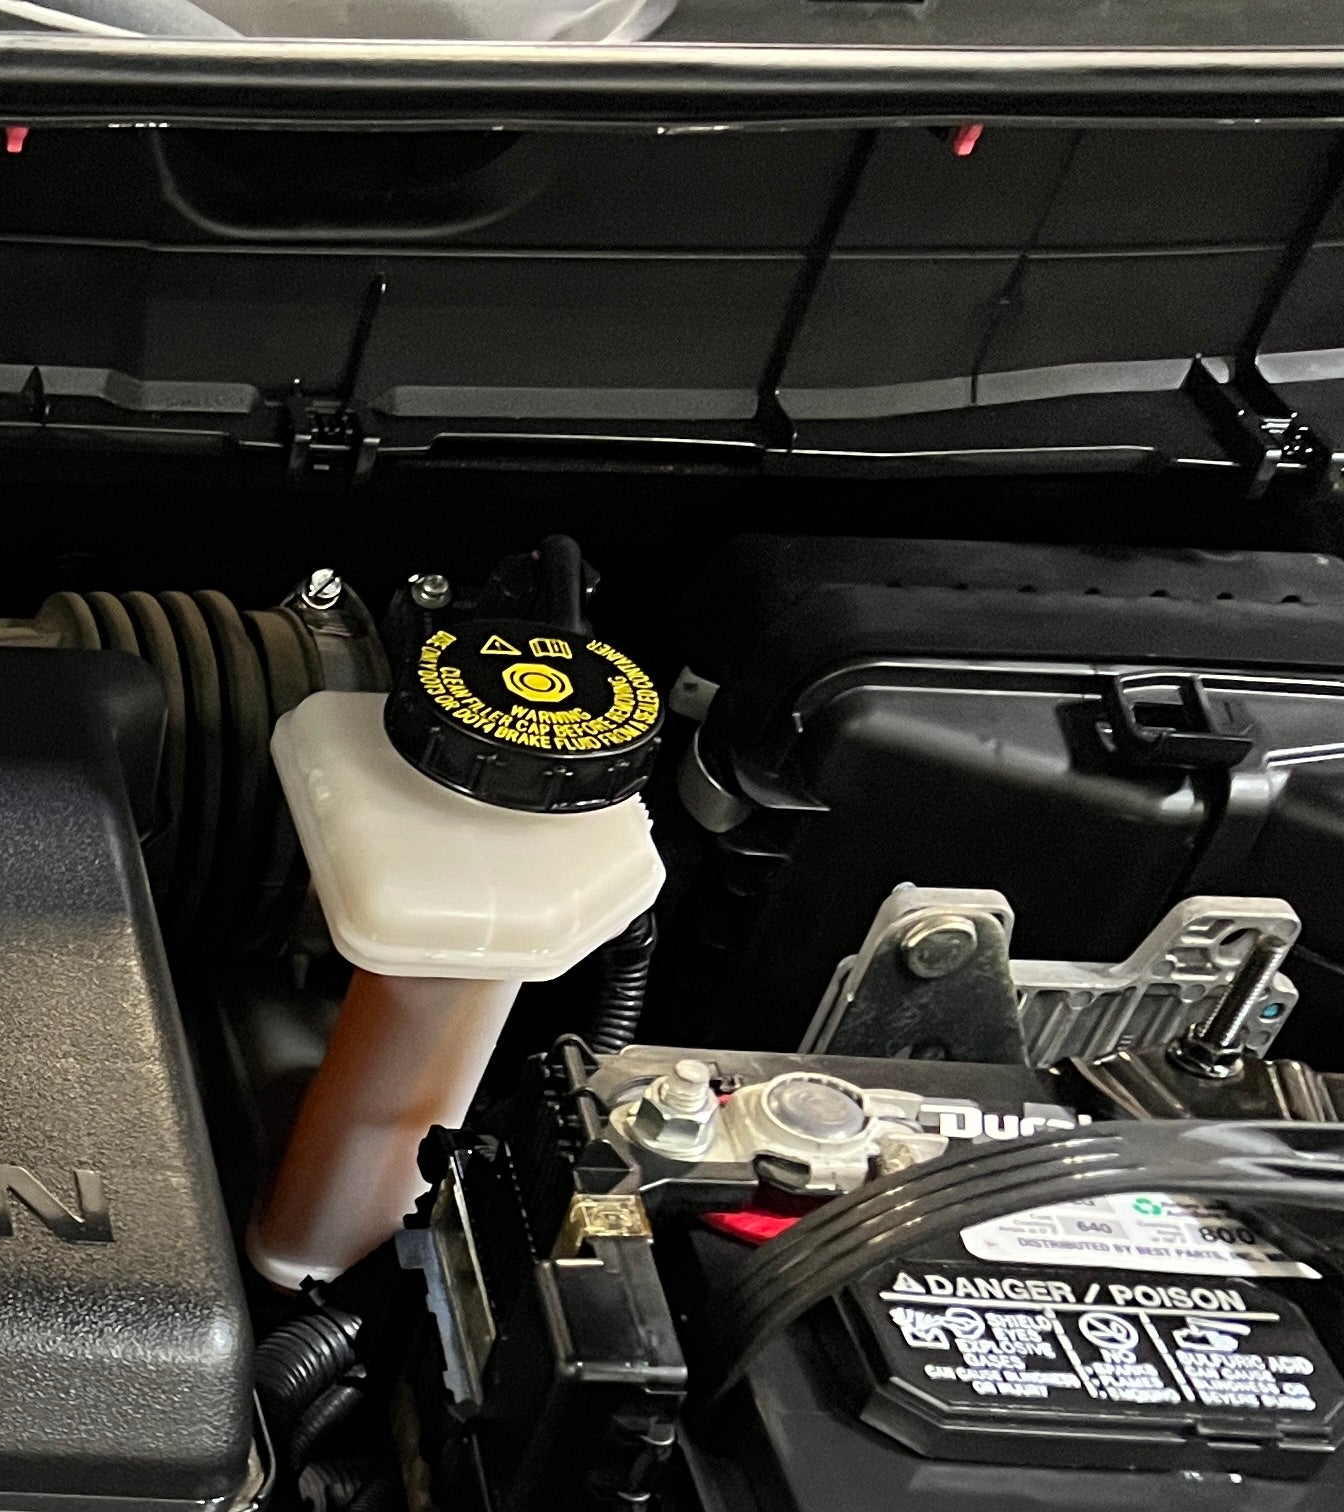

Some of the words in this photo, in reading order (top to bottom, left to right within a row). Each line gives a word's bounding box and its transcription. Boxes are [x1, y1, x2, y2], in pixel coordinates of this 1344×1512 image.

[586, 639, 654, 689] CONTAINER
[434, 695, 460, 711] OR
[439, 666, 472, 699] CLEAN
[461, 697, 513, 727] FILLER
[515, 719, 550, 736] CAP
[552, 716, 617, 737] BEFORE
[452, 708, 496, 733] DOT4
[511, 704, 592, 724] WARNING
[494, 726, 552, 749] BRAKE
[553, 735, 602, 751] FLUID
[597, 724, 642, 747] FROM
[1017, 1237, 1111, 1252] DISTRIBUTED
[1114, 1243, 1132, 1254] BY
[1198, 1226, 1256, 1245] 800
[923, 1274, 1077, 1303] DANGER
[1108, 1284, 1247, 1311] POISON
[984, 1312, 1053, 1332] SHIELD
[992, 1326, 1043, 1343] EYES
[954, 1337, 1057, 1360] EXPLOSIVE
[1099, 1348, 1138, 1364] NO
[963, 1352, 1027, 1372] GASES
[1175, 1349, 1267, 1370] SULFURIC
[1267, 1355, 1315, 1376] ACID
